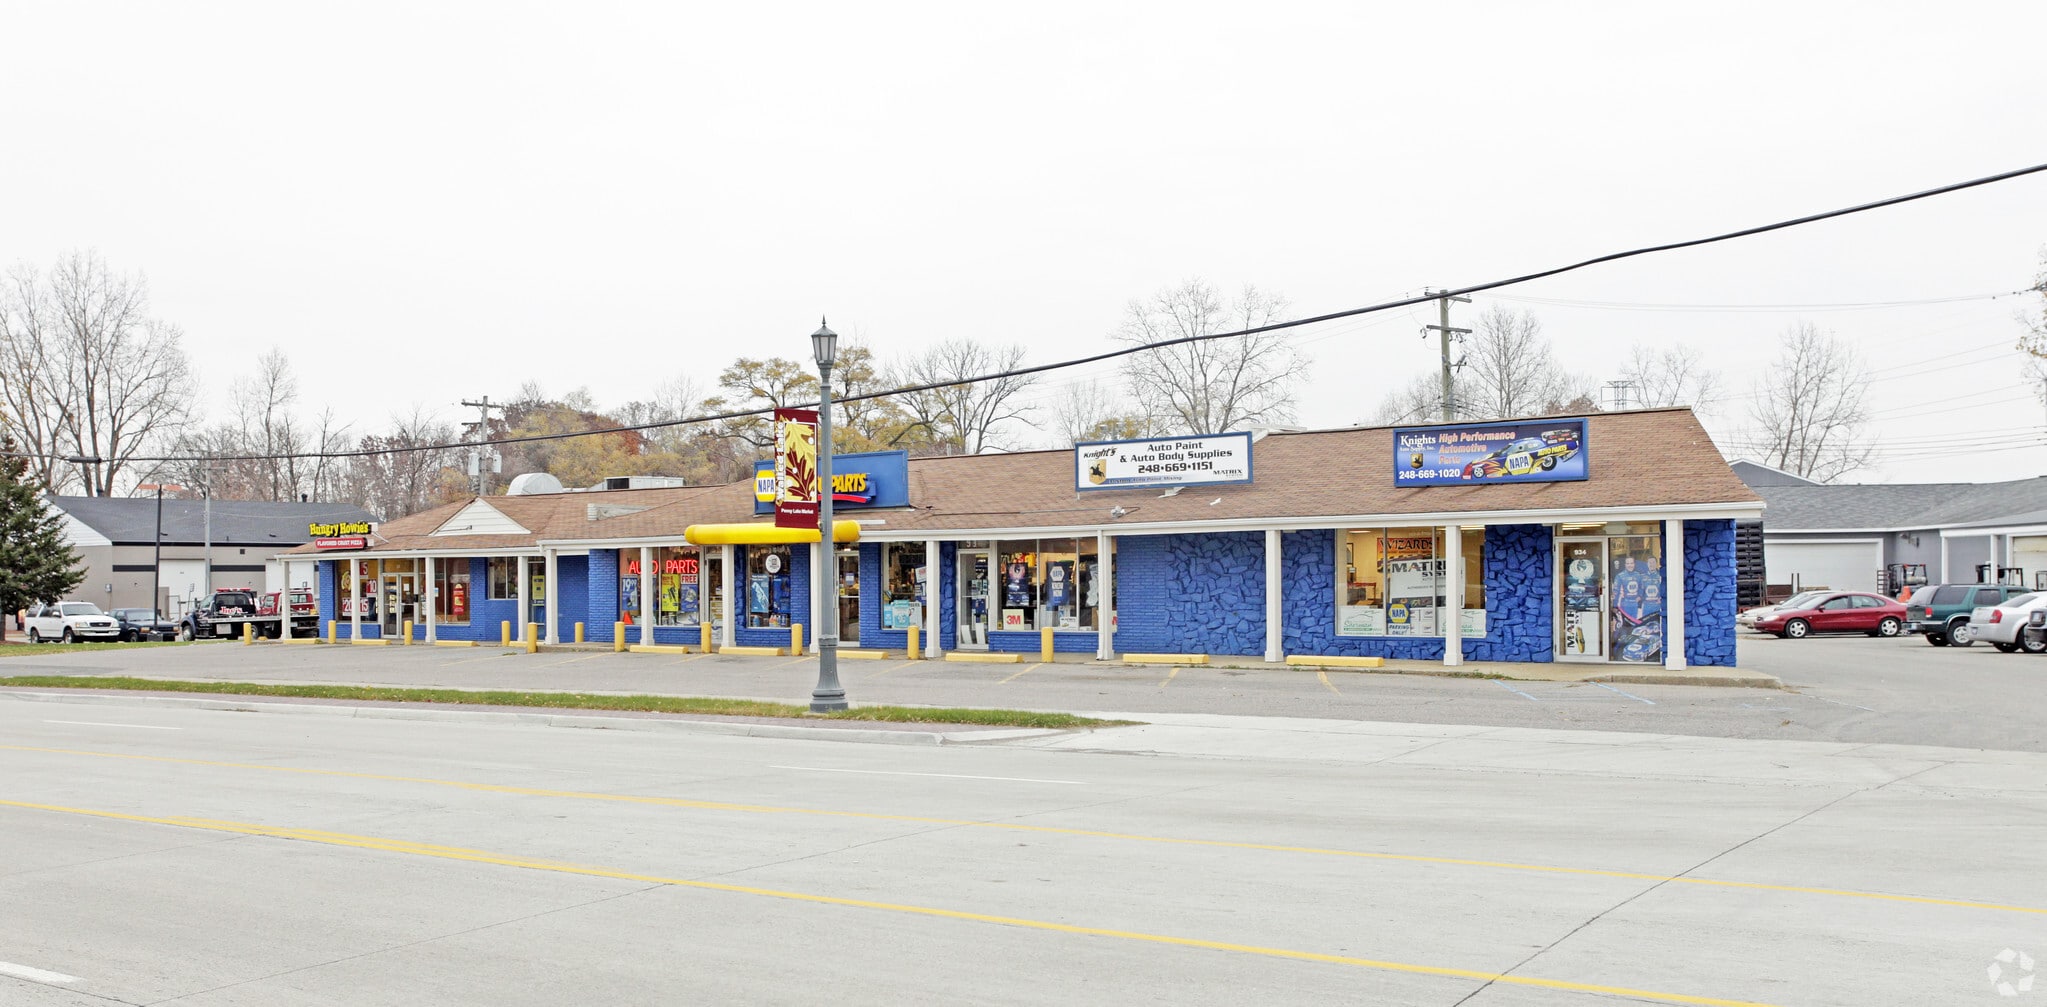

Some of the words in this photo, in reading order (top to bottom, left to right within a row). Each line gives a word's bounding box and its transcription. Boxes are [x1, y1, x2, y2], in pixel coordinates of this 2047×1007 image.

[1400, 433, 1437, 448] Knights
[1439, 433, 1459, 445] High
[1460, 429, 1517, 442] Performance
[1084, 447, 1117, 460] Knight's
[1147, 444, 1172, 453] Auto
[1175, 441, 1204, 451] Paint
[1438, 443, 1488, 454] Automotive
[1120, 455, 1128, 463] &
[1130, 454, 1156, 463] Auto
[1158, 451, 1184, 462] Body
[1187, 449, 1233, 460] Supplies
[1508, 455, 1530, 470] NAPA
[1212, 468, 1243, 476] MATRIX
[1398, 468, 1461, 480] 248-669-1020
[758, 479, 775, 493] NAPA
[309, 523, 339, 537] Hungry
[628, 559, 659, 575] AUO
[665, 559, 699, 574] PARTS
[1391, 560, 1447, 574] MATRI
[681, 575, 698, 583] FREE
[1391, 608, 1406, 618] NAPA
[1006, 615, 1021, 625] 3M
